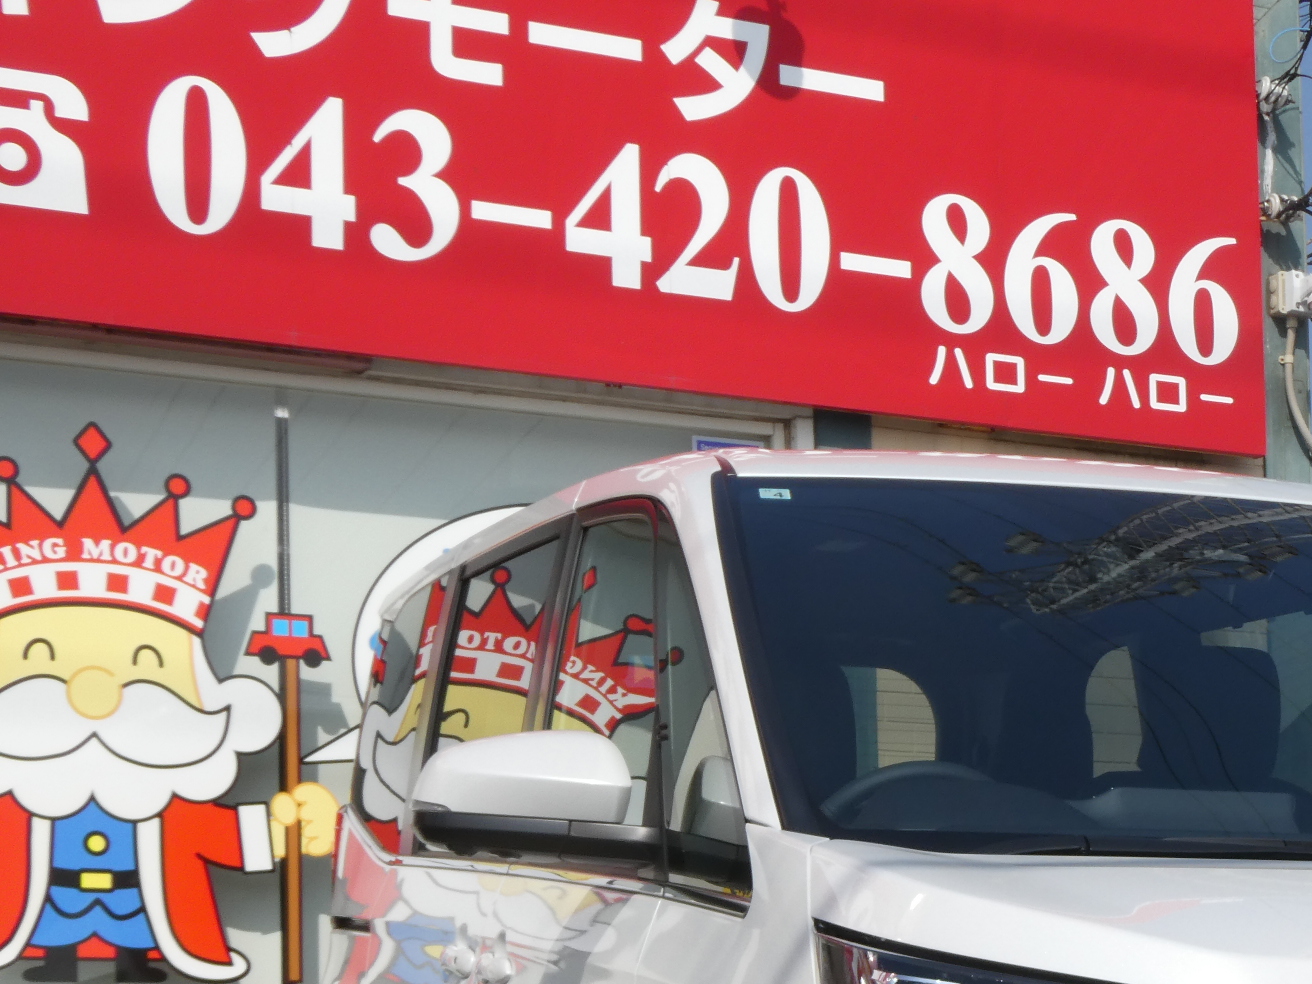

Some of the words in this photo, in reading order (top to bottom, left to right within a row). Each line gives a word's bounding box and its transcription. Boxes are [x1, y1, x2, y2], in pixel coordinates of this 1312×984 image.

[0, 0, 885, 121] モーター
[147, 75, 1240, 366] 043-420-8686
[929, 345, 1074, 394] ハロー
[1098, 366, 1234, 413] ハロー
[0, 537, 67, 570] ING
[80, 537, 209, 590] MOTOR
